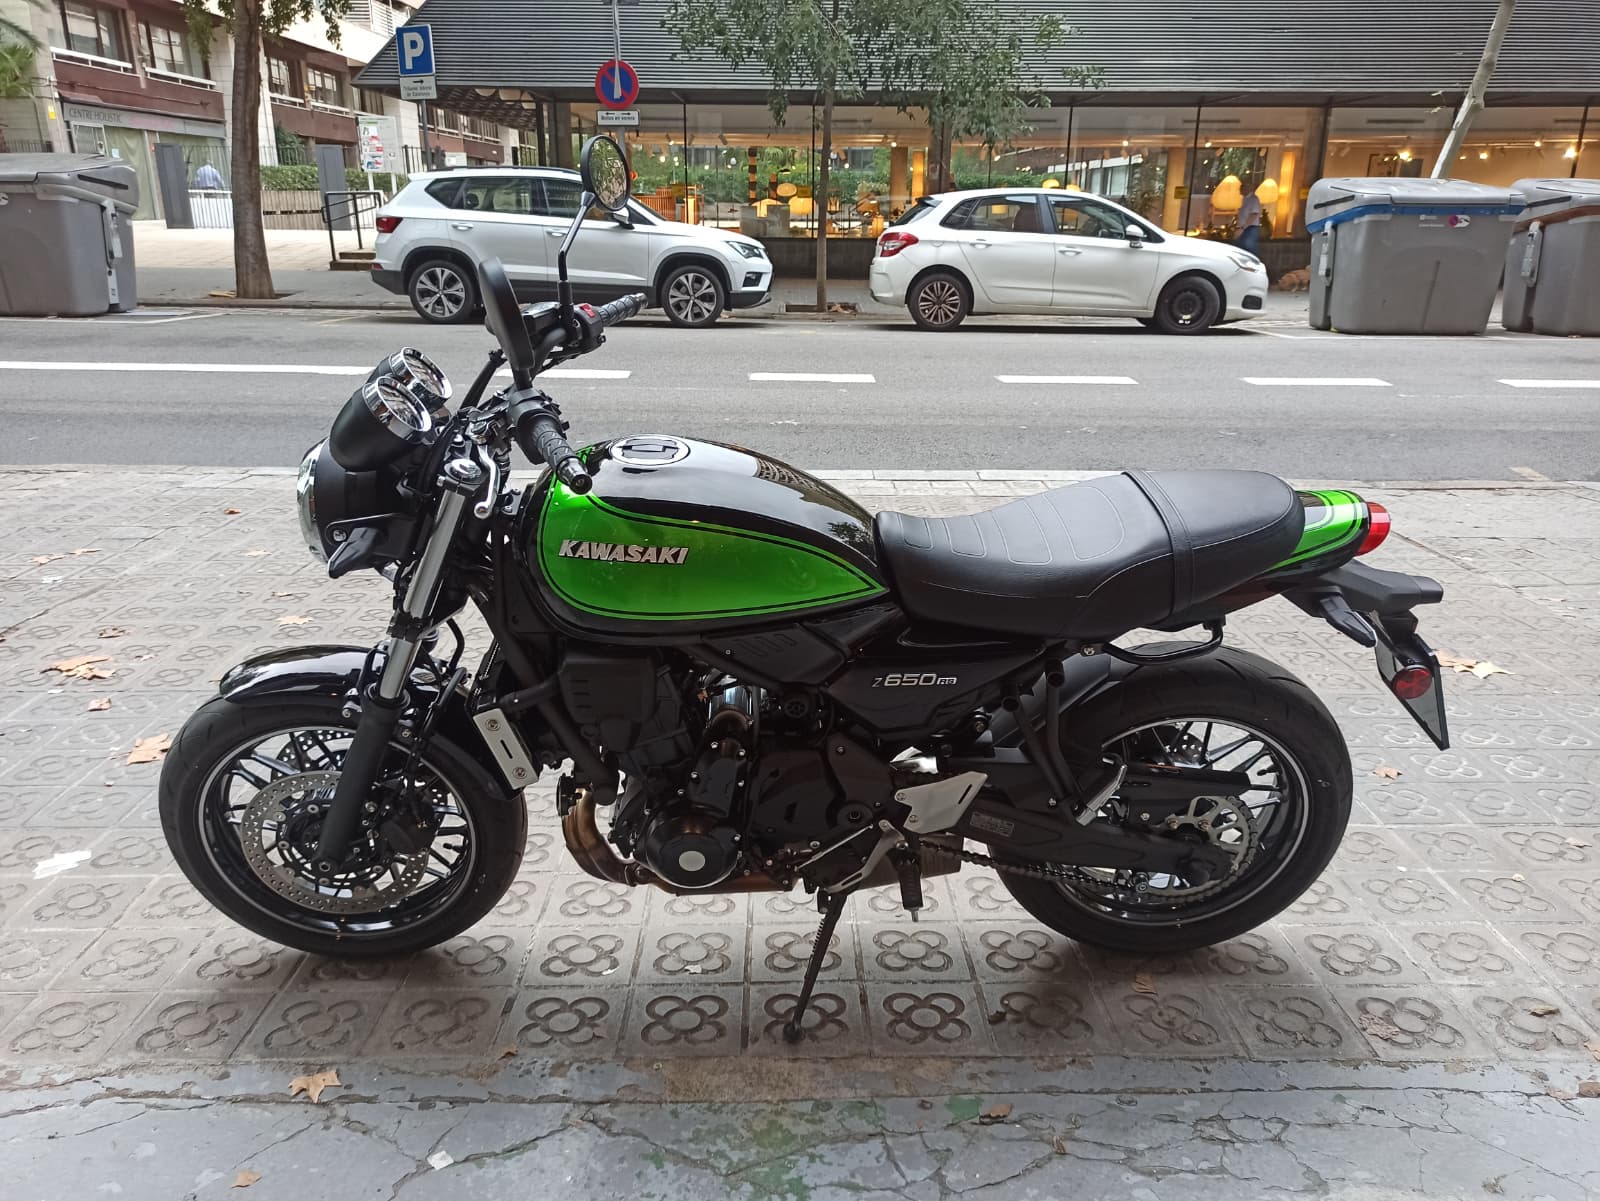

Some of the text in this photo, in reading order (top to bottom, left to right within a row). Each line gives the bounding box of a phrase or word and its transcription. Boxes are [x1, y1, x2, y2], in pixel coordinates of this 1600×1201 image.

[403, 32, 424, 70] P
[69, 108, 92, 120] CENTRE
[558, 539, 689, 564] KAWASAKI
